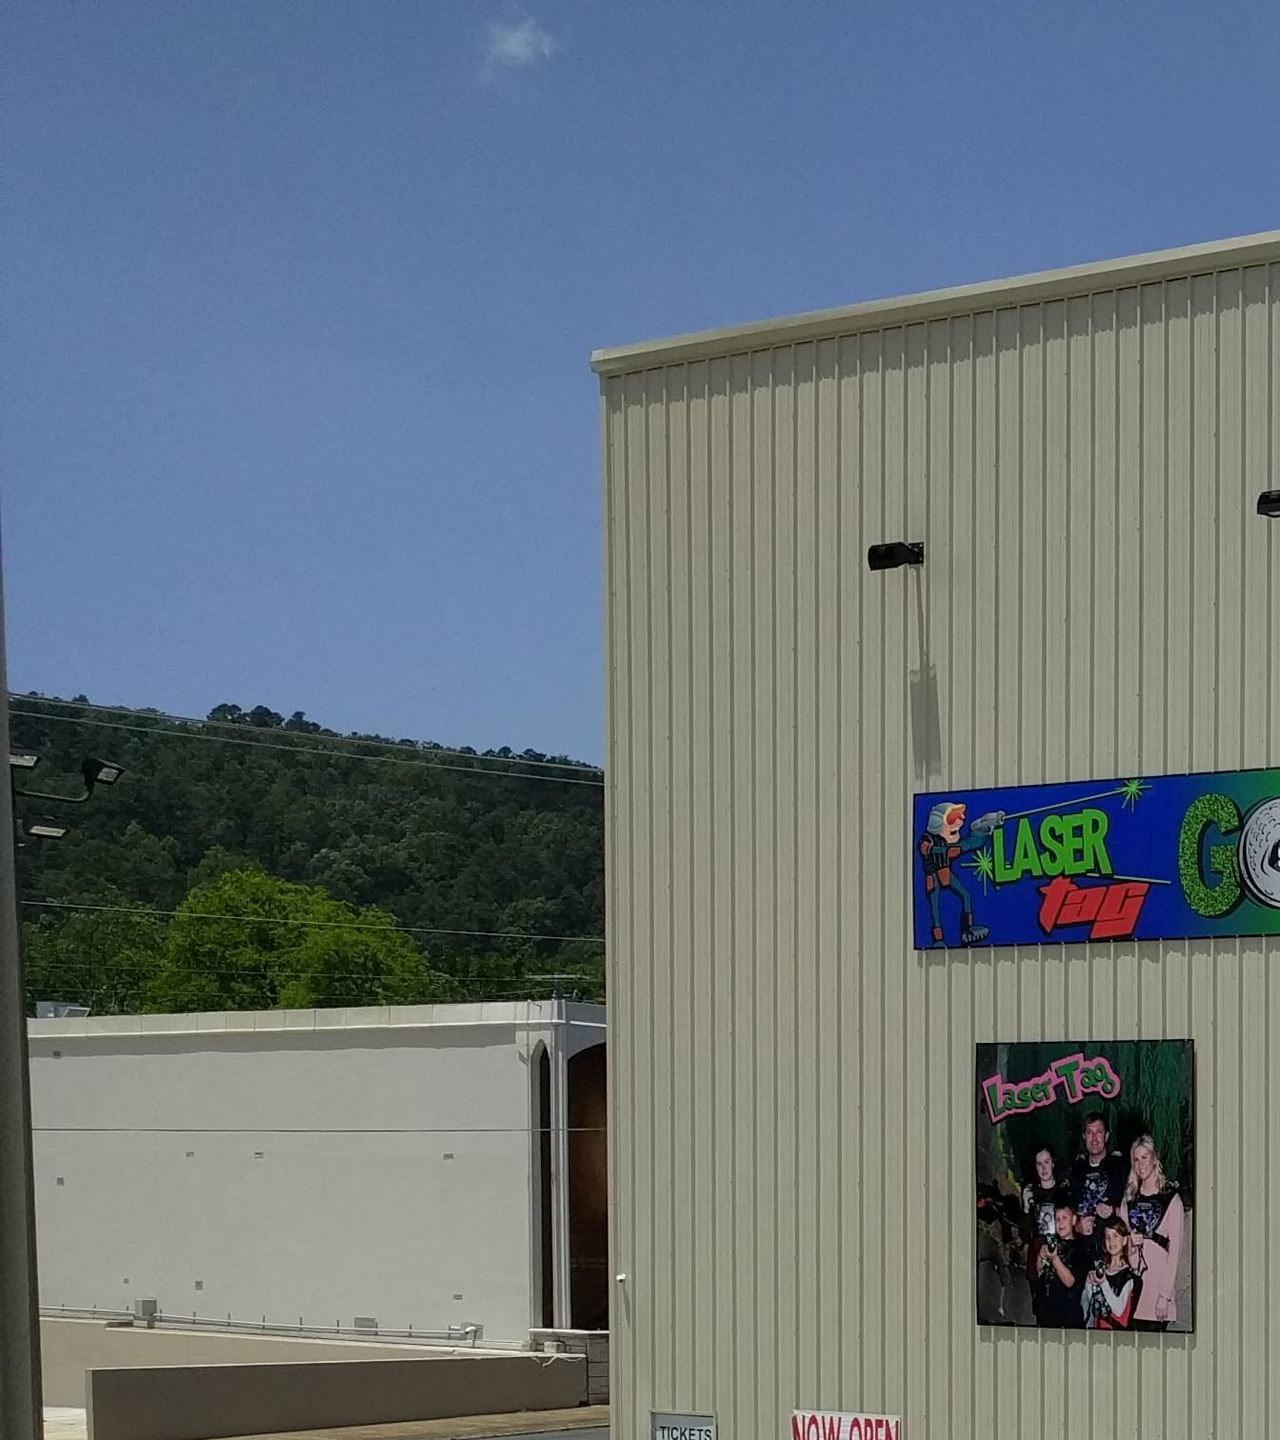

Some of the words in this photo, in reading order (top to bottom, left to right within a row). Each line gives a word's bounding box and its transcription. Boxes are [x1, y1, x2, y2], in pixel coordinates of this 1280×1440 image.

[993, 808, 1114, 889] LASER
[986, 1078, 1053, 1118] Laser
[1054, 1057, 1117, 1100] Tag
